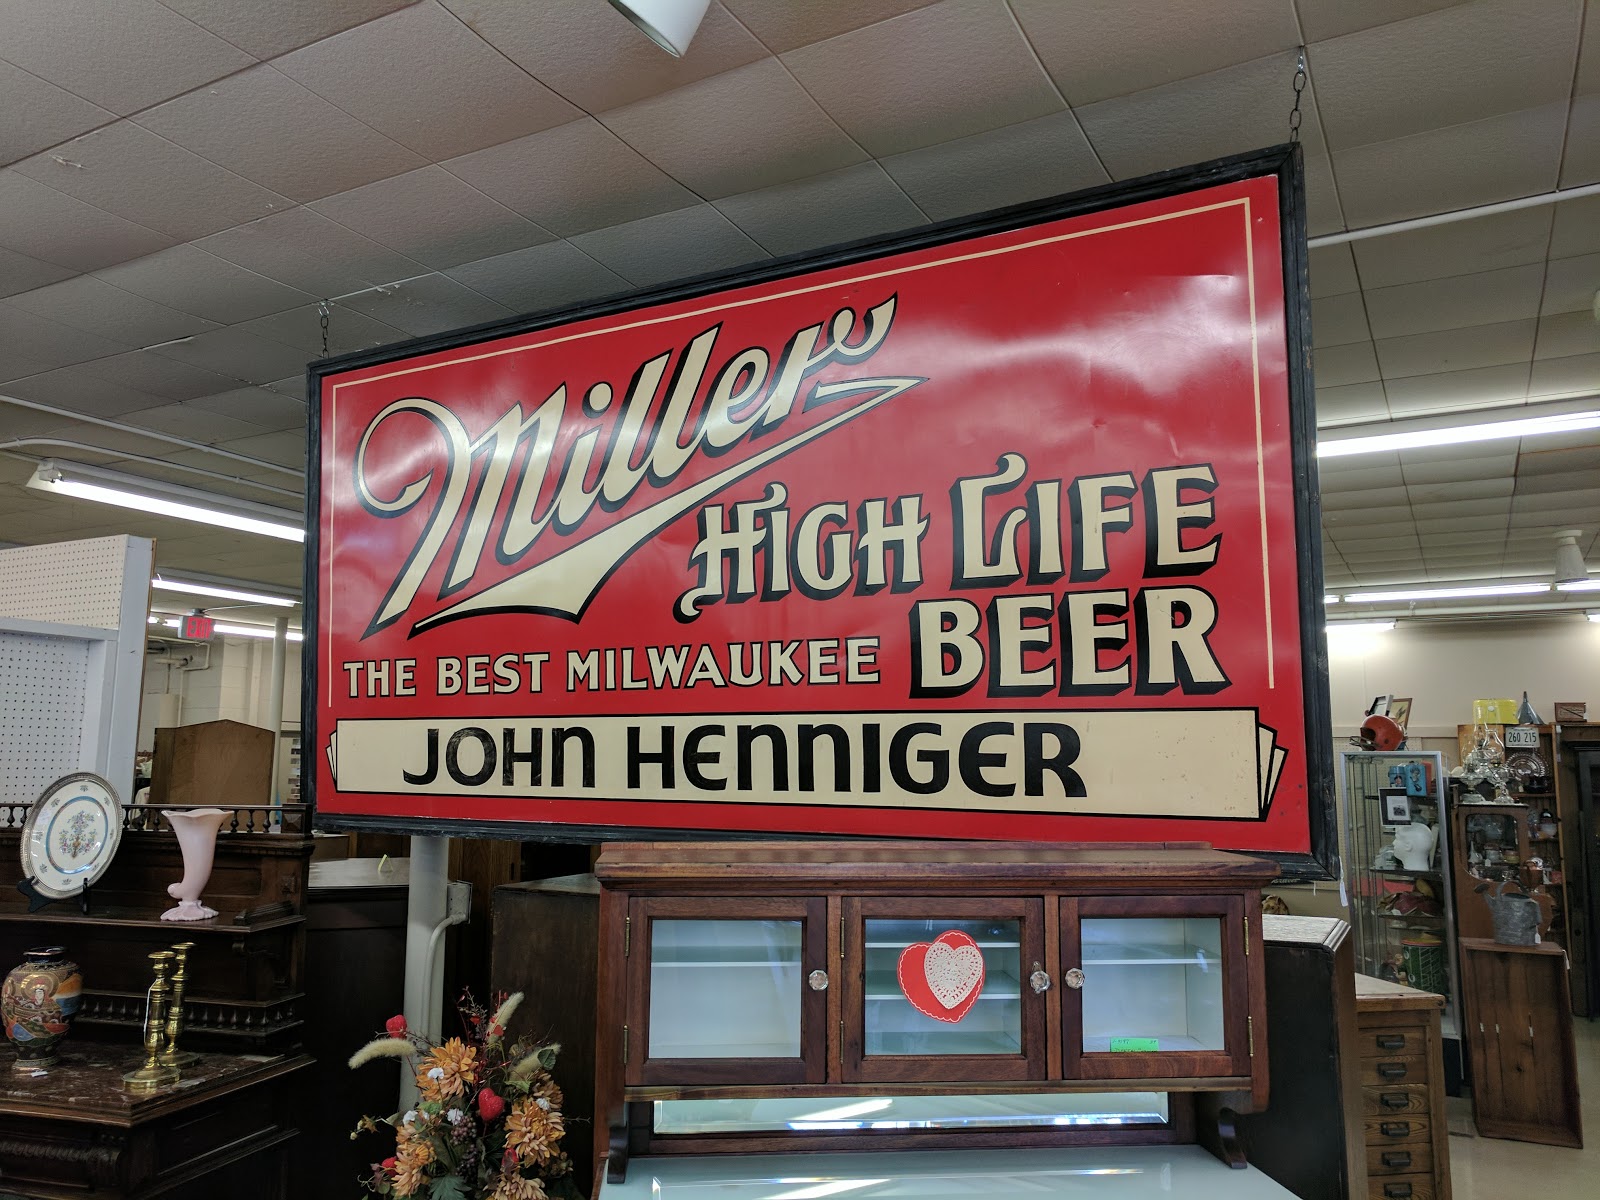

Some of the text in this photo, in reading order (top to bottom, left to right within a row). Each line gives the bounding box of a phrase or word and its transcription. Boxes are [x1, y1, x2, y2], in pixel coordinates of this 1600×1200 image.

[355, 293, 898, 641] Miller
[673, 452, 1222, 622] HIGH LIFE
[187, 616, 212, 639] EXIT
[343, 585, 1232, 699] THE BEST MILWAUKEE BEER
[1508, 732, 1537, 743] 260 215
